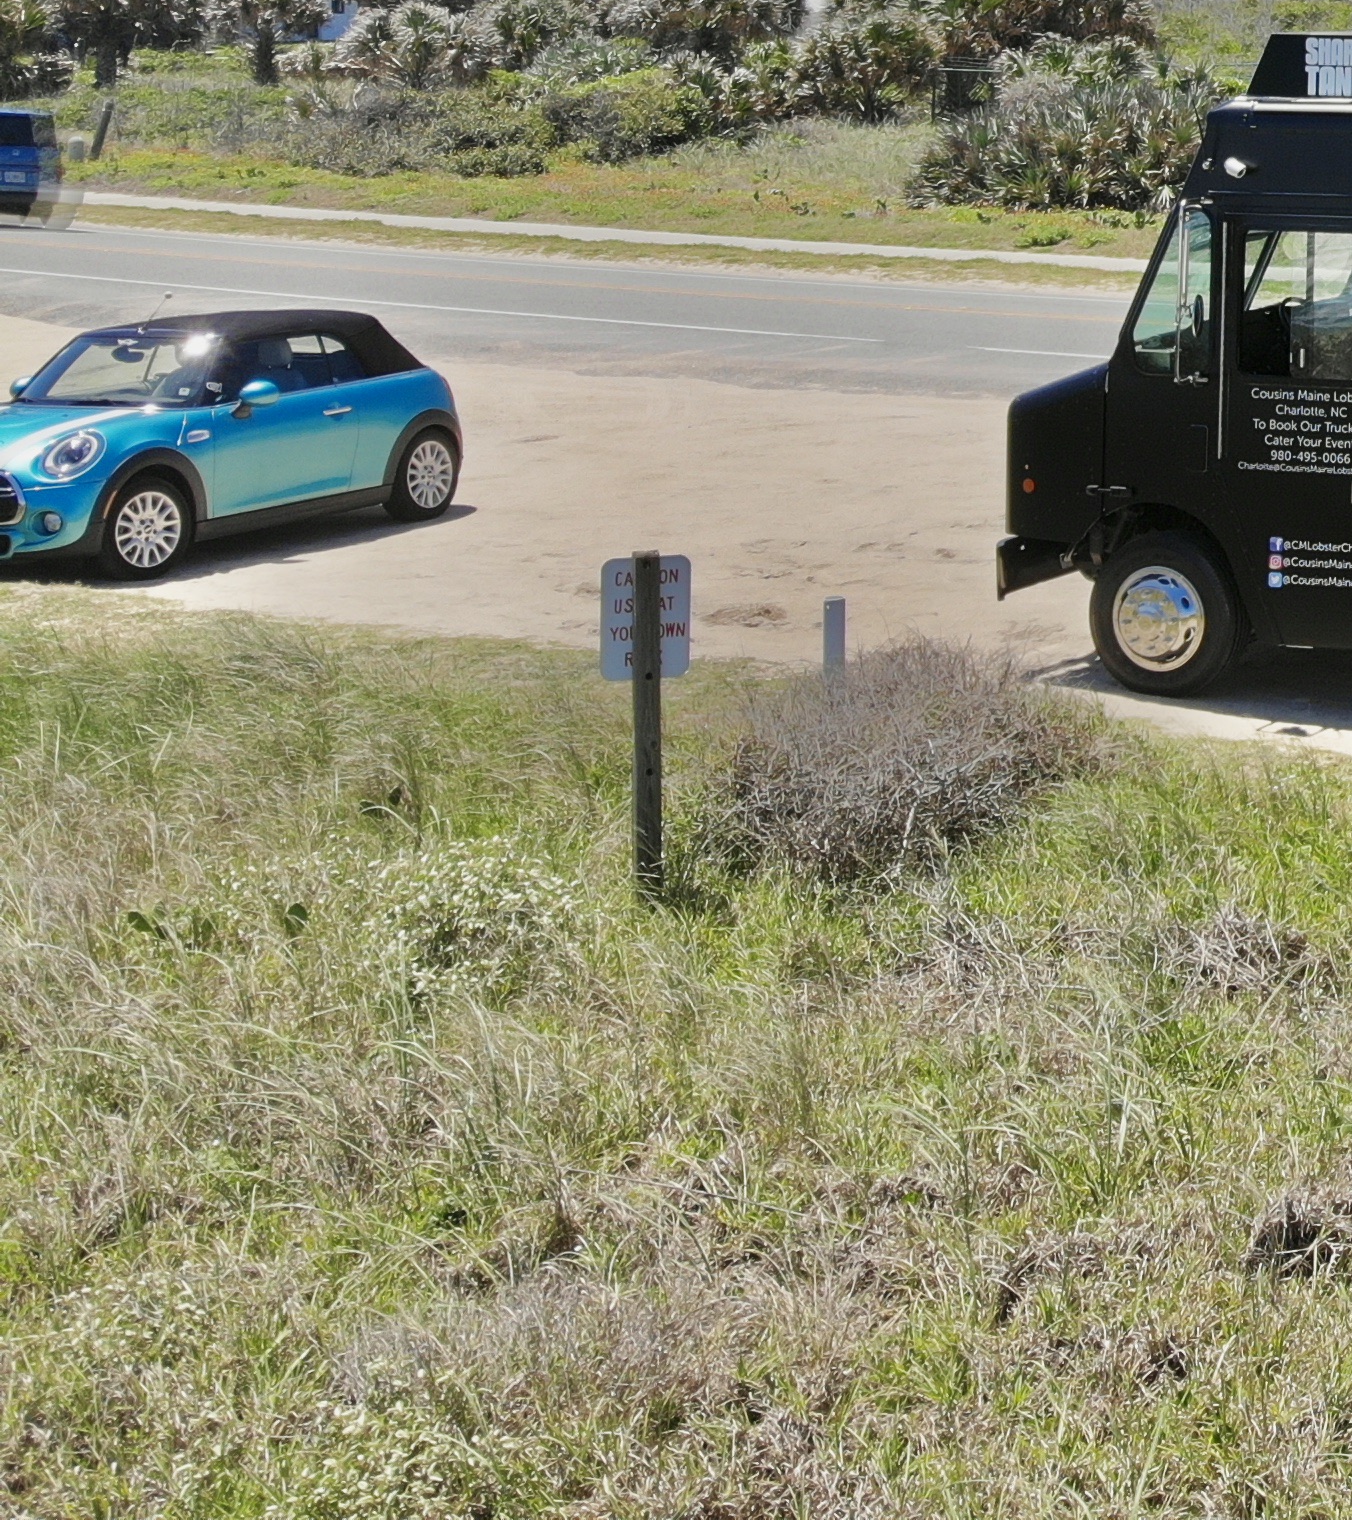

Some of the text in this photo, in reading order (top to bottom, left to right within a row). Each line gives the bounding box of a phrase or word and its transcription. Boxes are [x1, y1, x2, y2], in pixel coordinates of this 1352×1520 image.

[1251, 387, 1295, 401] Cousins
[1297, 389, 1331, 402] Maine
[1275, 404, 1348, 418] Charlotte, NC
[1253, 418, 1266, 430] To
[1269, 419, 1298, 431] Book
[1300, 420, 1321, 432] Our
[1264, 434, 1294, 447] Cater
[1297, 435, 1322, 448] Your
[1270, 450, 1351, 465] 980-495-0066
[615, 568, 679, 587] CAON
